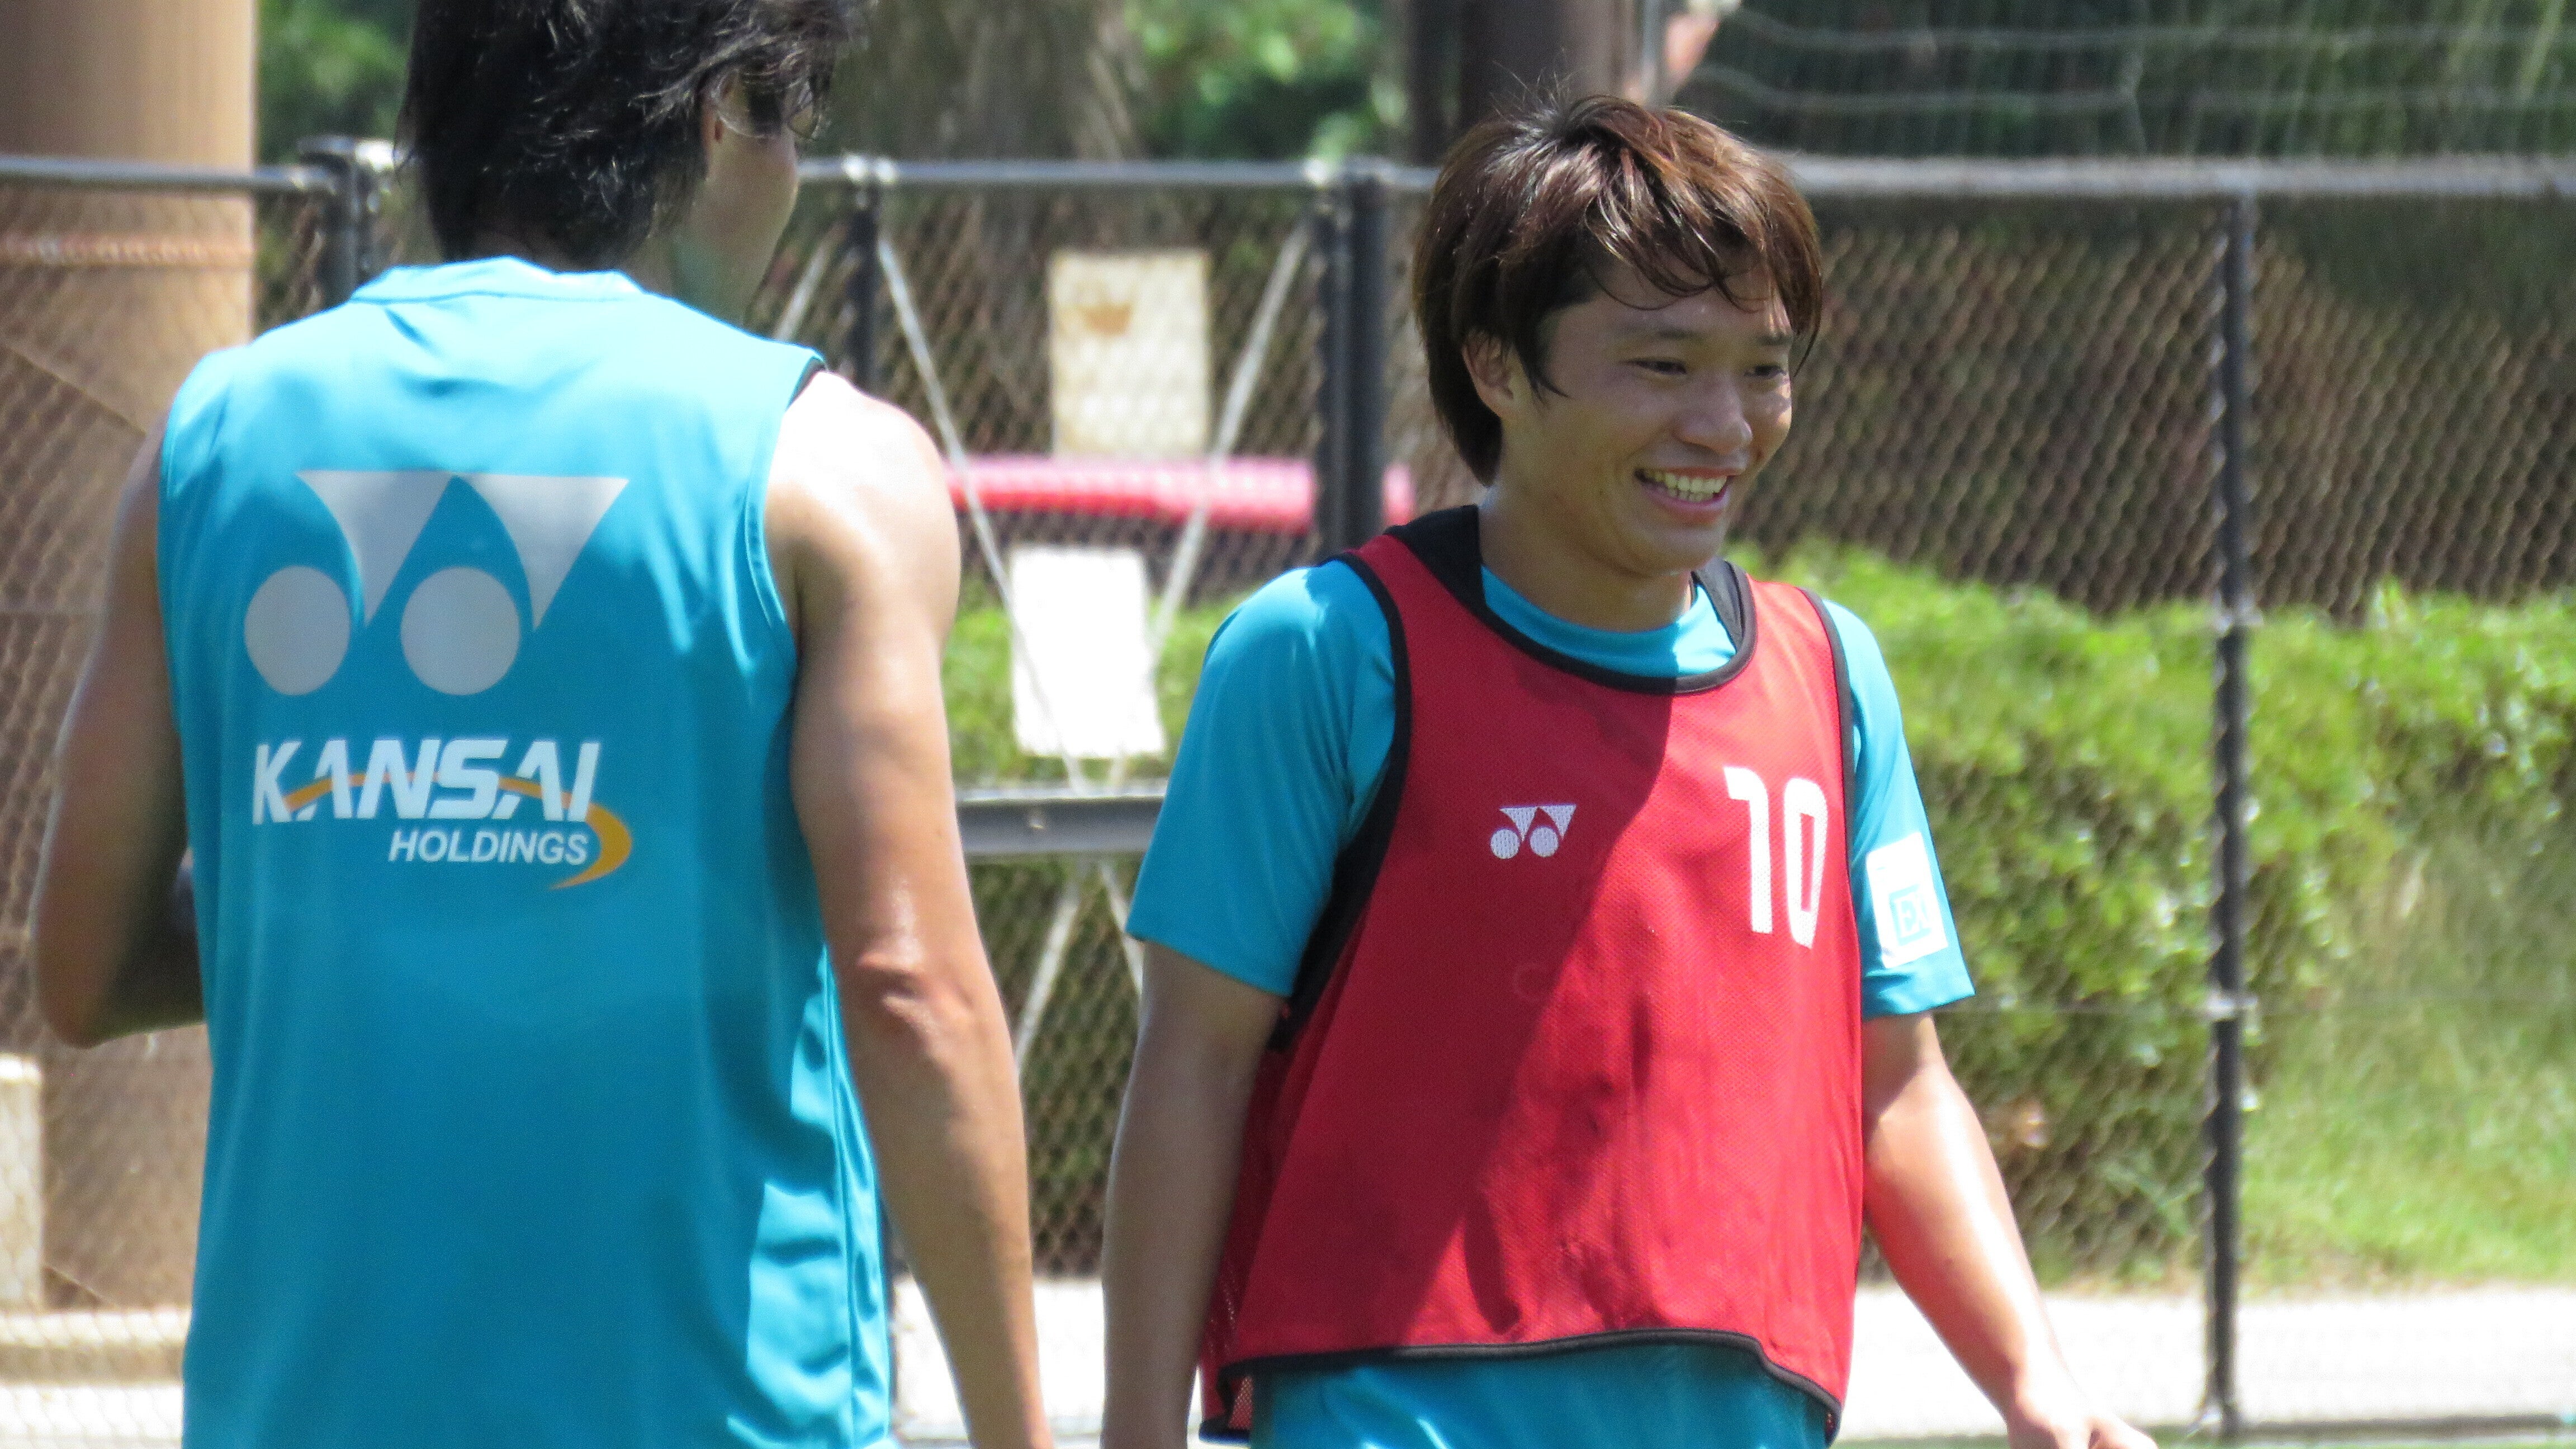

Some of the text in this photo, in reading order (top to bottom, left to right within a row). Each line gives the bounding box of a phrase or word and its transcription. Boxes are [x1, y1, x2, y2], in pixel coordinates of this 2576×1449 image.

[252, 738, 601, 825] KANSAI
[388, 829, 589, 865] HOLDINGS
[1723, 765, 1829, 949] 10
